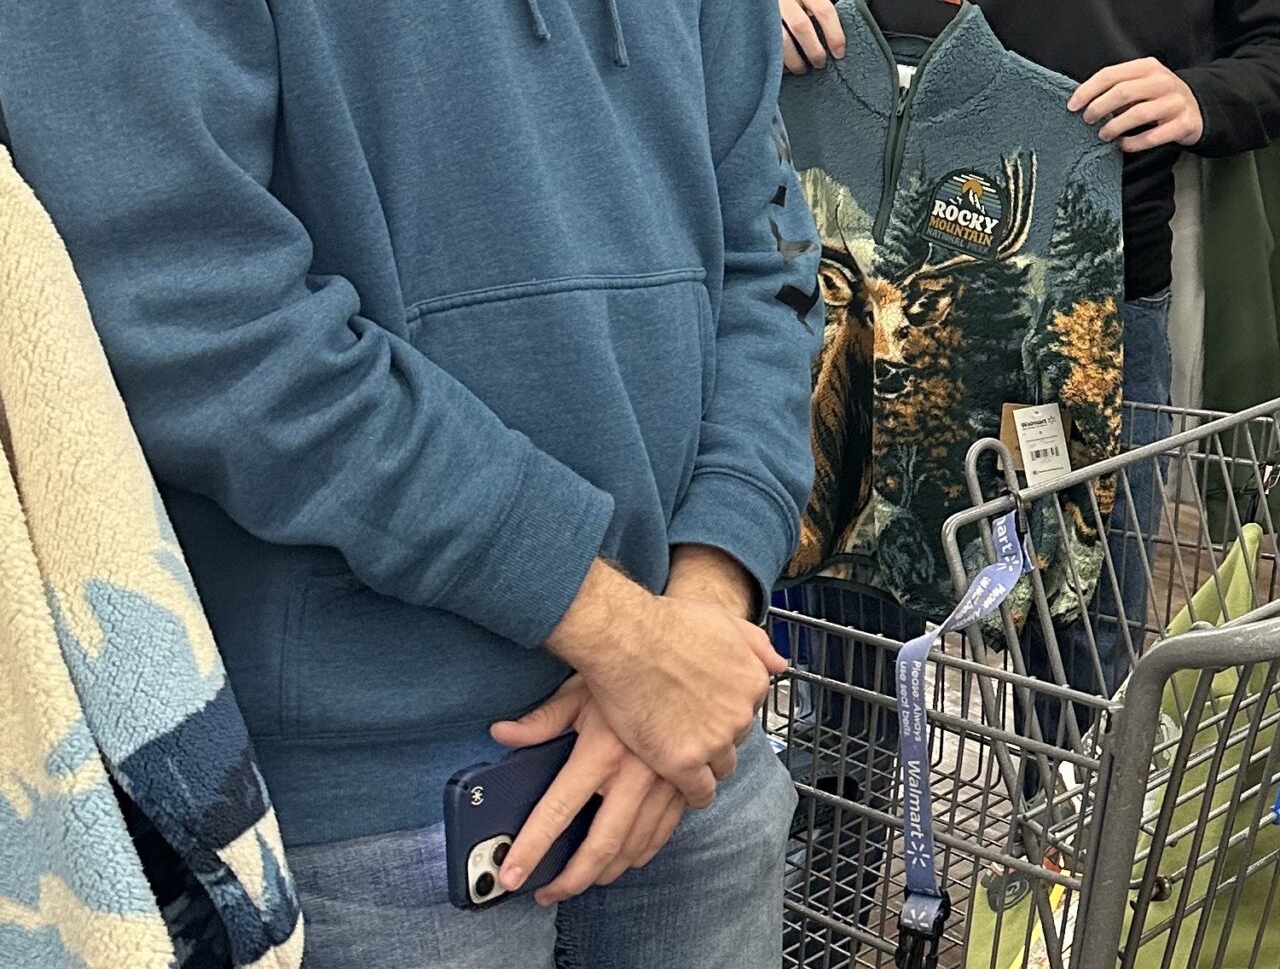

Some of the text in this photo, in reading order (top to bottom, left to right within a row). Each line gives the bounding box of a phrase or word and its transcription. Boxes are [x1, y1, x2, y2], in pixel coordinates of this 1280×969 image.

[928, 215, 994, 247] MOUNTAIN
[931, 199, 999, 234] ROCKY
[900, 684, 910, 708] seat
[912, 703, 923, 742] Always
[906, 760, 924, 839] Walmart
